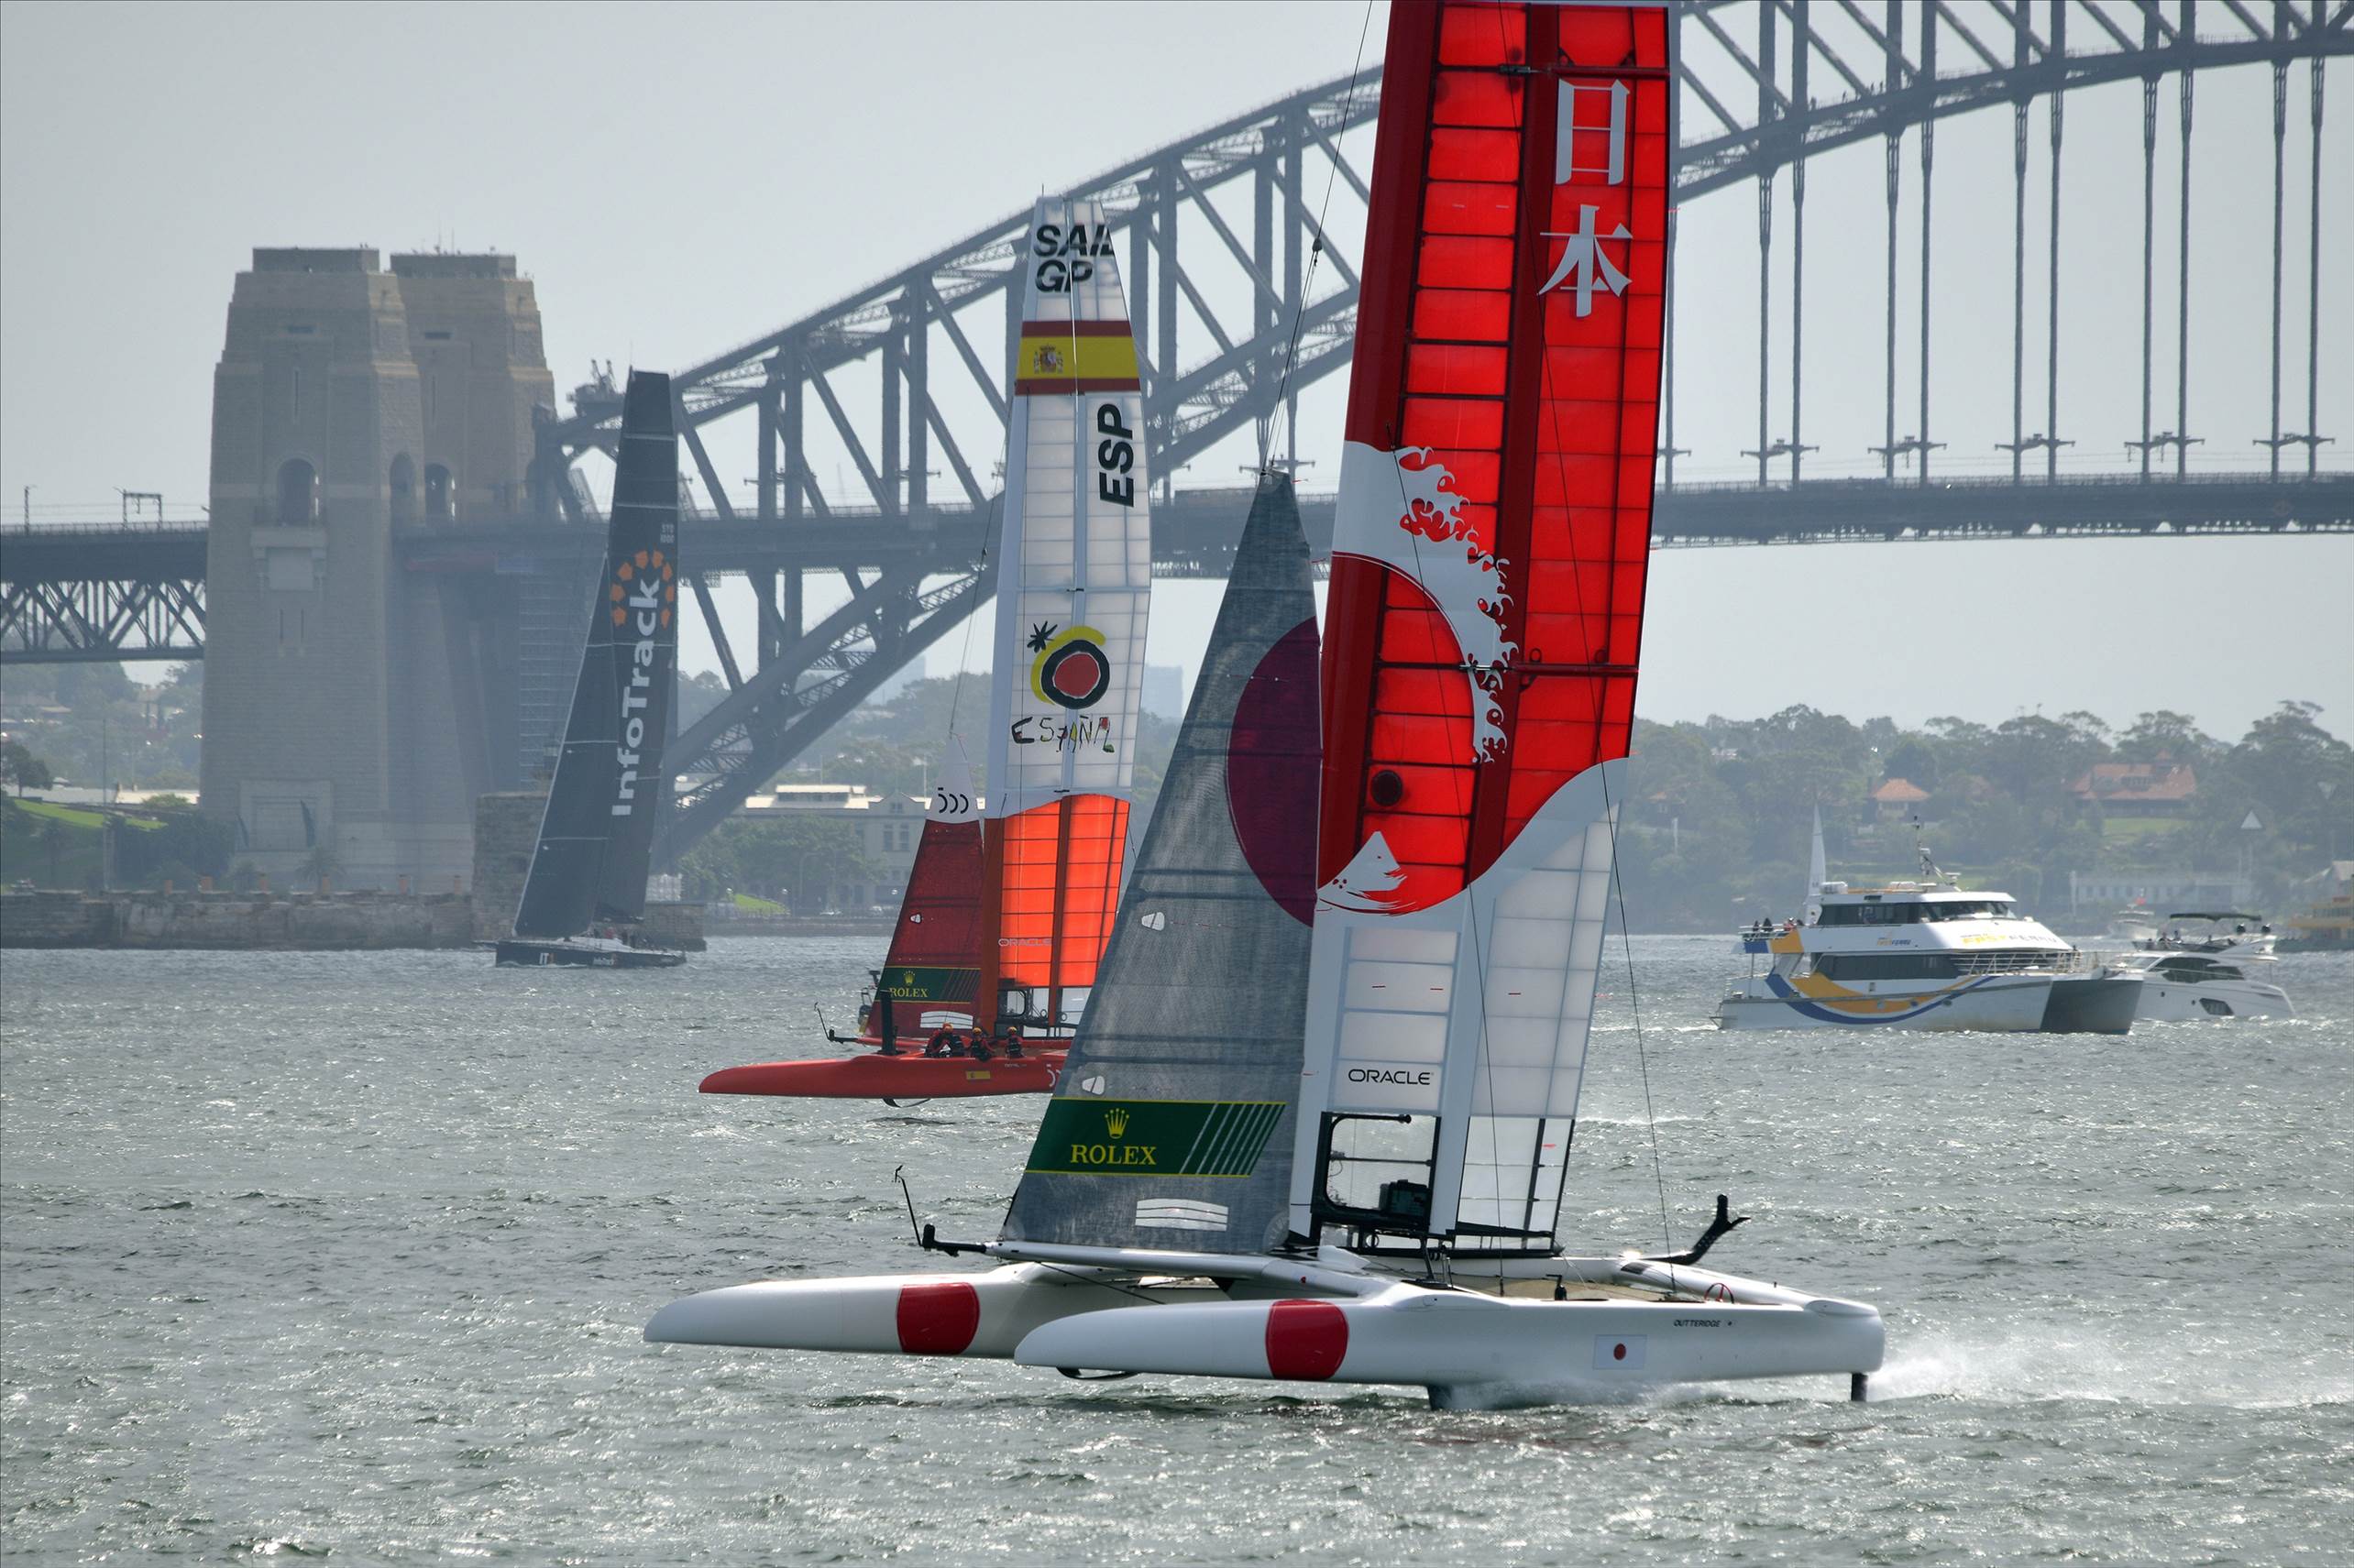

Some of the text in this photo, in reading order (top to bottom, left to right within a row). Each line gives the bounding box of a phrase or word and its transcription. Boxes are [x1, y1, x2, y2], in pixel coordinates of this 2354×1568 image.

[1537, 78, 1634, 318] 日本
[1035, 259, 1093, 293] GP
[1096, 402, 1135, 508] ESP
[611, 579, 661, 817] InfoTrack
[1011, 714, 1116, 753] ESPAÑA
[998, 938, 1053, 947] ORACLE
[889, 987, 929, 997] ROLEX
[1348, 1069, 1431, 1085] ORACLE
[1070, 1144, 1158, 1166] ROLEX
